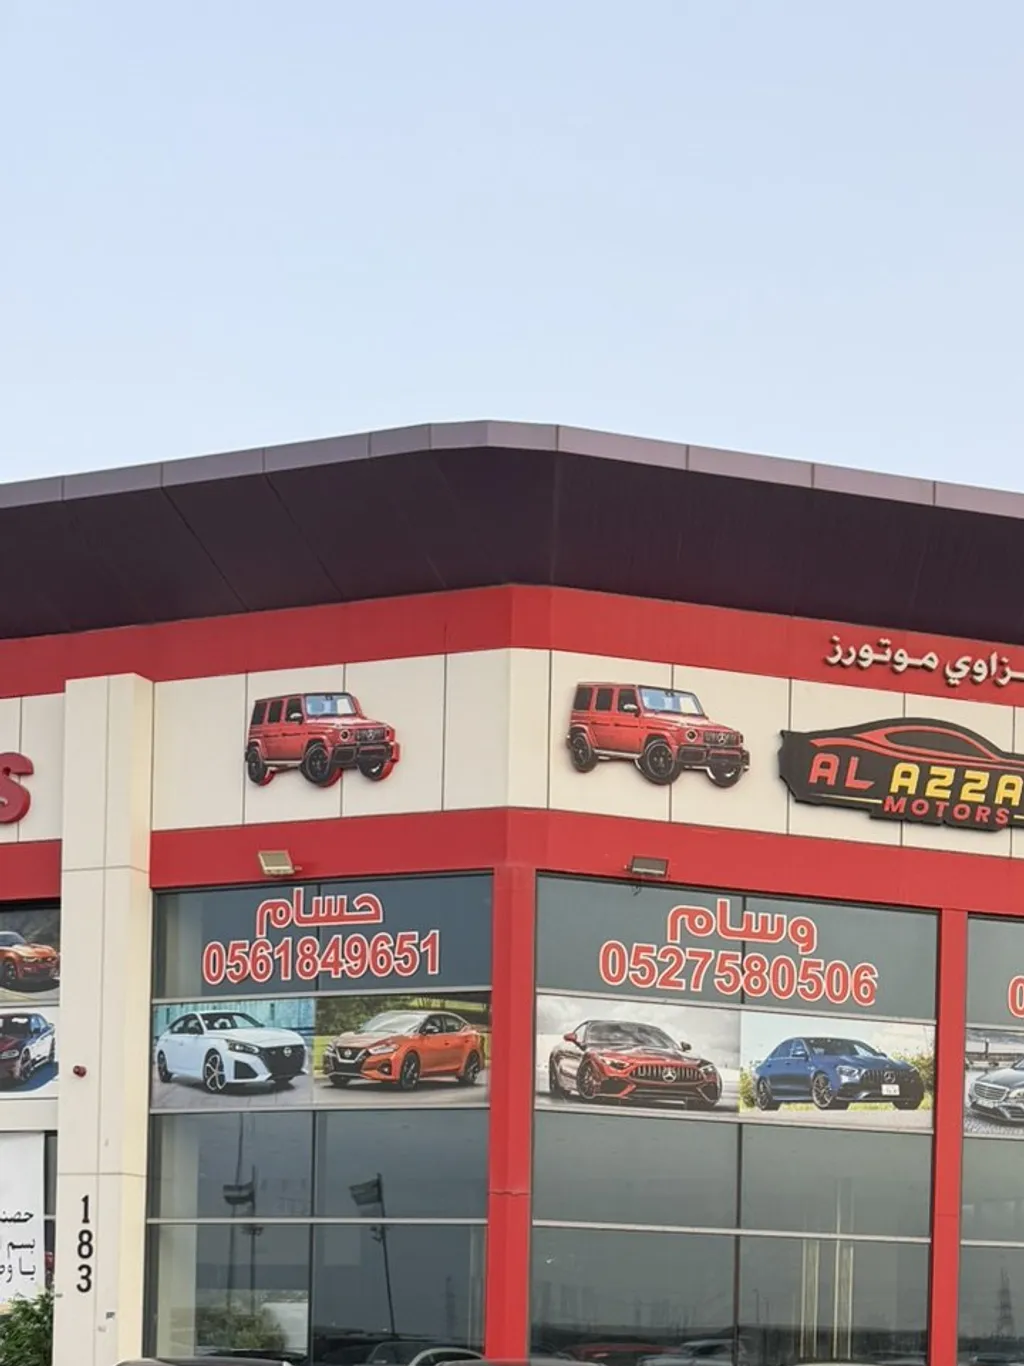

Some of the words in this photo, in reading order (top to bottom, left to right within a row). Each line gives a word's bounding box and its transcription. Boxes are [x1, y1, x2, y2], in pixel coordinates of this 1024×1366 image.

[825, 635, 940, 673] موتورز
[808, 753, 875, 790] AL
[882, 795, 1011, 825] MOTORS
[256, 887, 383, 938] حسام
[667, 898, 818, 955] وسام
[203, 930, 440, 985] 0561849651
[600, 940, 879, 1006] 0527580506
[77, 1194, 94, 1293] 183
